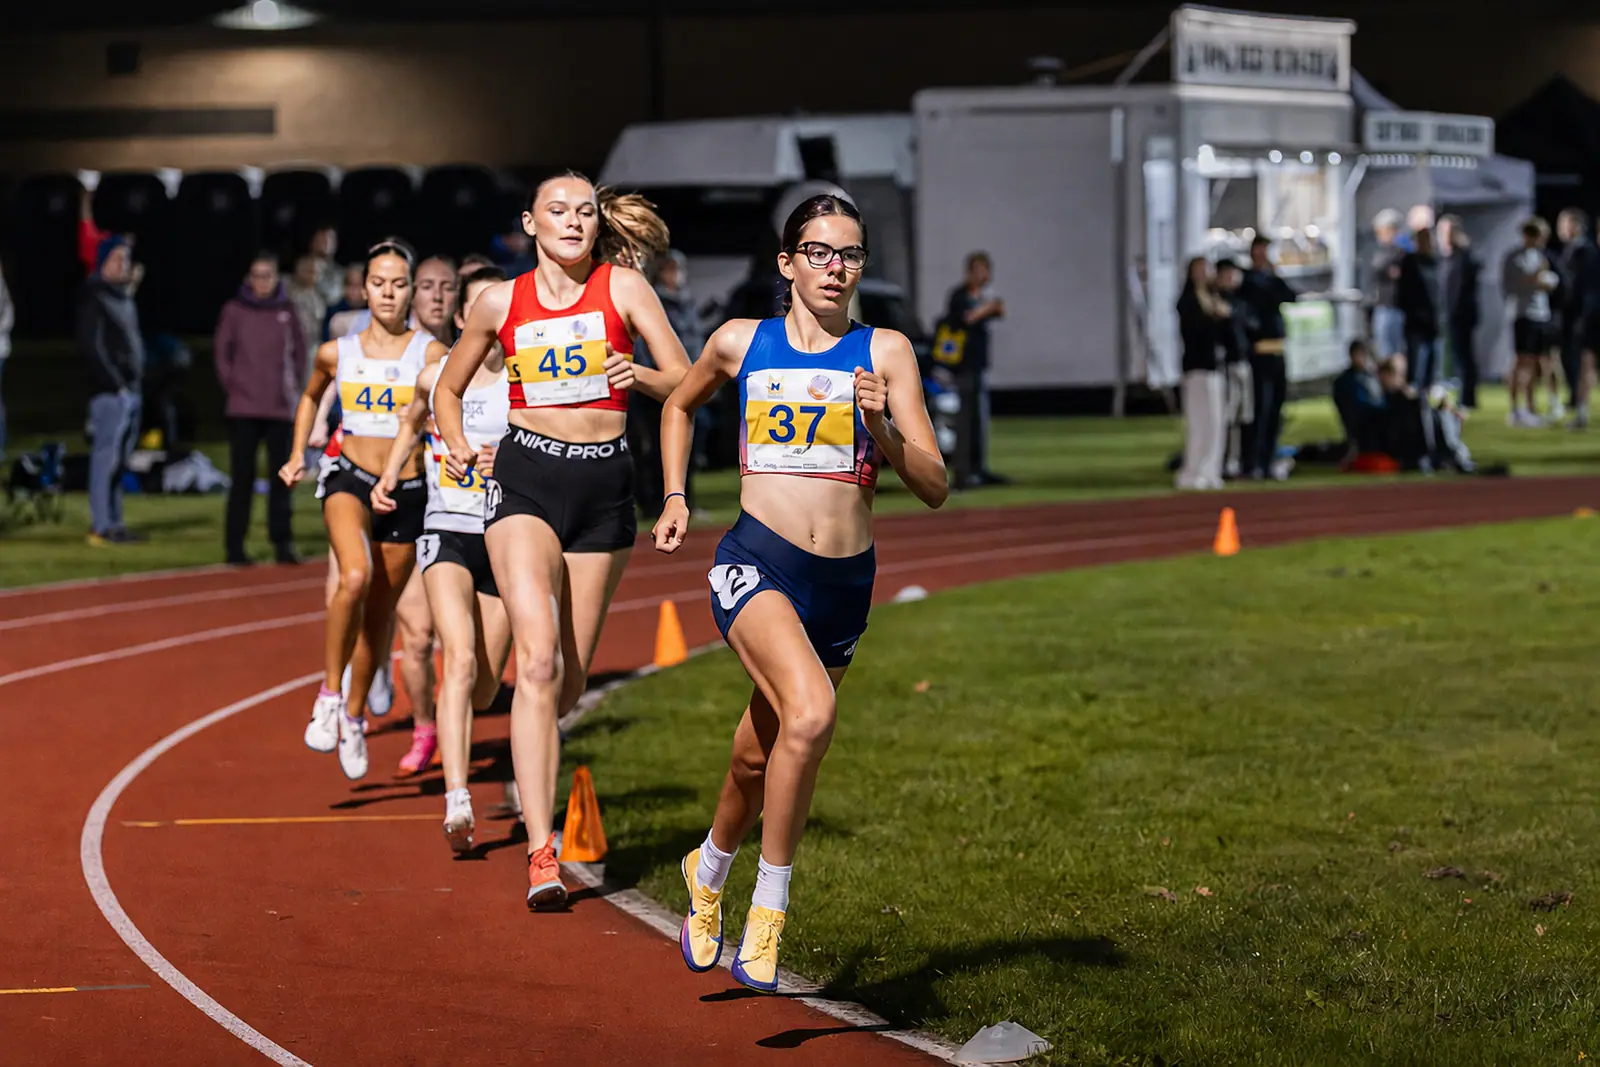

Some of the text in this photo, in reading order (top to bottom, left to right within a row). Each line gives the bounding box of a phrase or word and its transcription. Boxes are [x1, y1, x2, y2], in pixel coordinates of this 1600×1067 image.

[538, 344, 587, 378] 45
[355, 386, 396, 412] 44
[768, 404, 827, 444] 37
[513, 429, 565, 457] NIKE
[566, 443, 615, 460] PRO
[725, 564, 748, 597] 2
